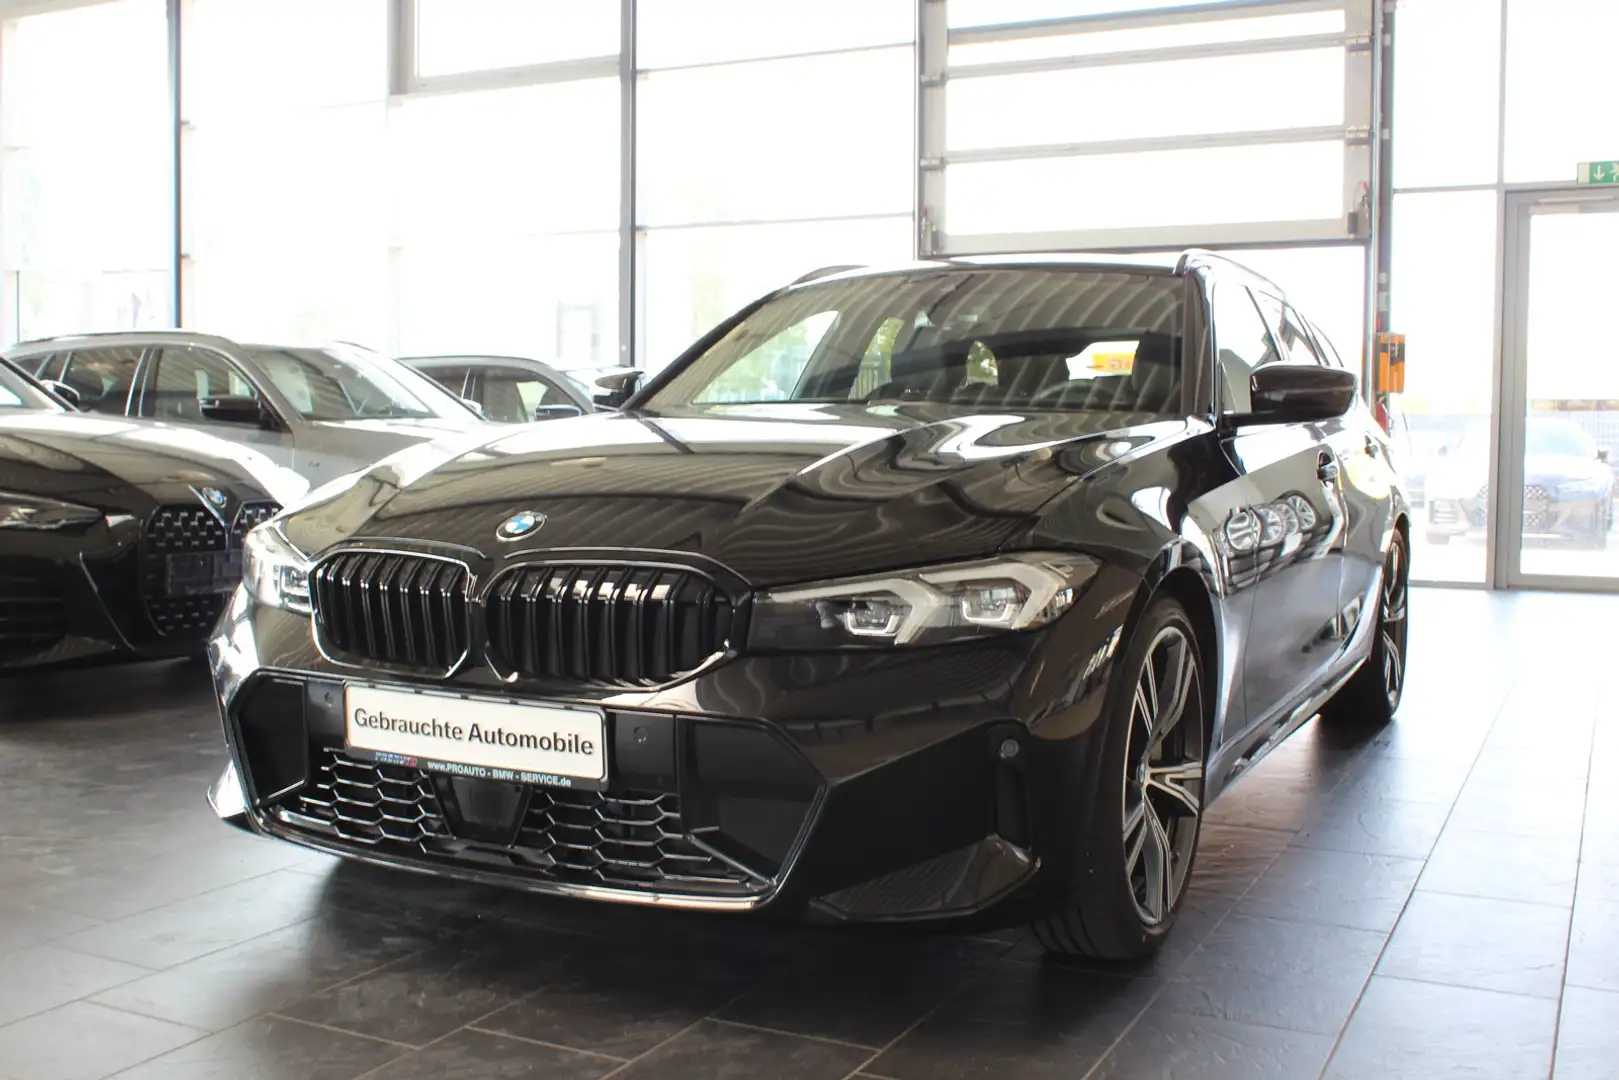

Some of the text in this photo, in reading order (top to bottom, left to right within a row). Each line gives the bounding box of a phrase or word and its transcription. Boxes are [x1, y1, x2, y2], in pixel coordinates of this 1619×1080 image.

[354, 707, 594, 756] Gebrauchte Automobile
[492, 768, 514, 780] BMW
[521, 771, 572, 788] SERVICE.de
